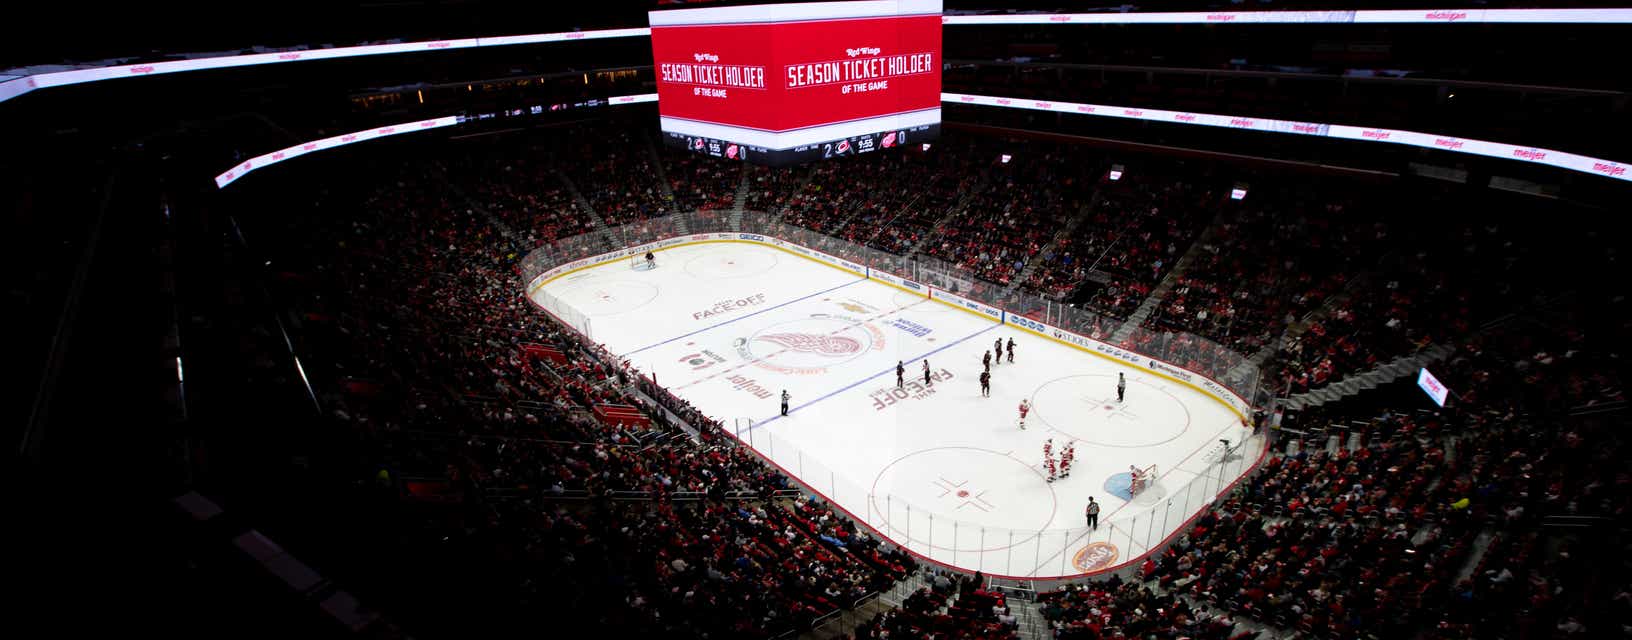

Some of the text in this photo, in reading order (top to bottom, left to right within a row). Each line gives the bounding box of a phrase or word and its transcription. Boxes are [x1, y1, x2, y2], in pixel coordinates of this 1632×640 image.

[661, 64, 764, 88] SEASON TICKET HOLDER
[788, 53, 932, 87] SEASON TICKET HOLDER
[694, 88, 727, 98] OF THE GAME
[842, 81, 888, 94] OF THE GAME
[687, 137, 693, 150] 2
[709, 143, 721, 153] 9:55
[739, 146, 746, 160] 0
[824, 131, 906, 158] 2 9:55 0
[1513, 149, 1547, 160] meijer
[1593, 162, 1627, 176] meijer
[740, 233, 764, 241] GEICO
[692, 293, 765, 320] FACE-OFF
[726, 374, 773, 400] meijer
